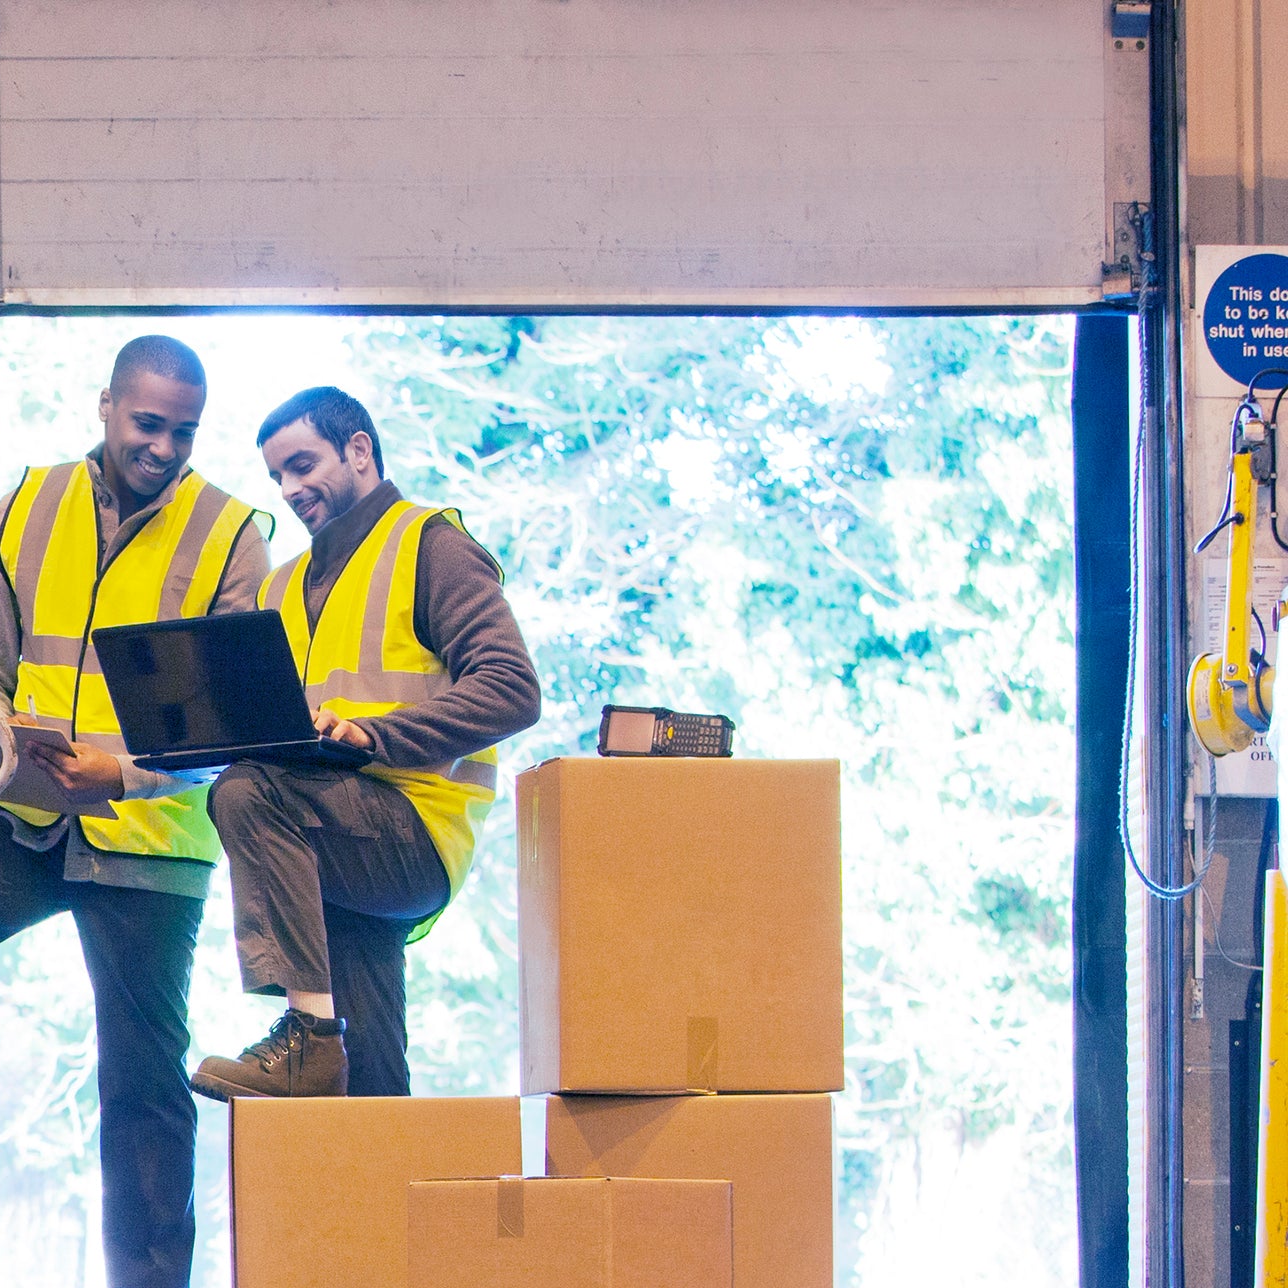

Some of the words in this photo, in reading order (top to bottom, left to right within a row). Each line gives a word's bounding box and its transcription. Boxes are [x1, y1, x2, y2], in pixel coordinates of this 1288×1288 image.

[1228, 286, 1263, 301] This
[1224, 305, 1242, 320] to
[1248, 304, 1269, 320] be
[1209, 323, 1245, 339] shut
[1242, 341, 1258, 357] in
